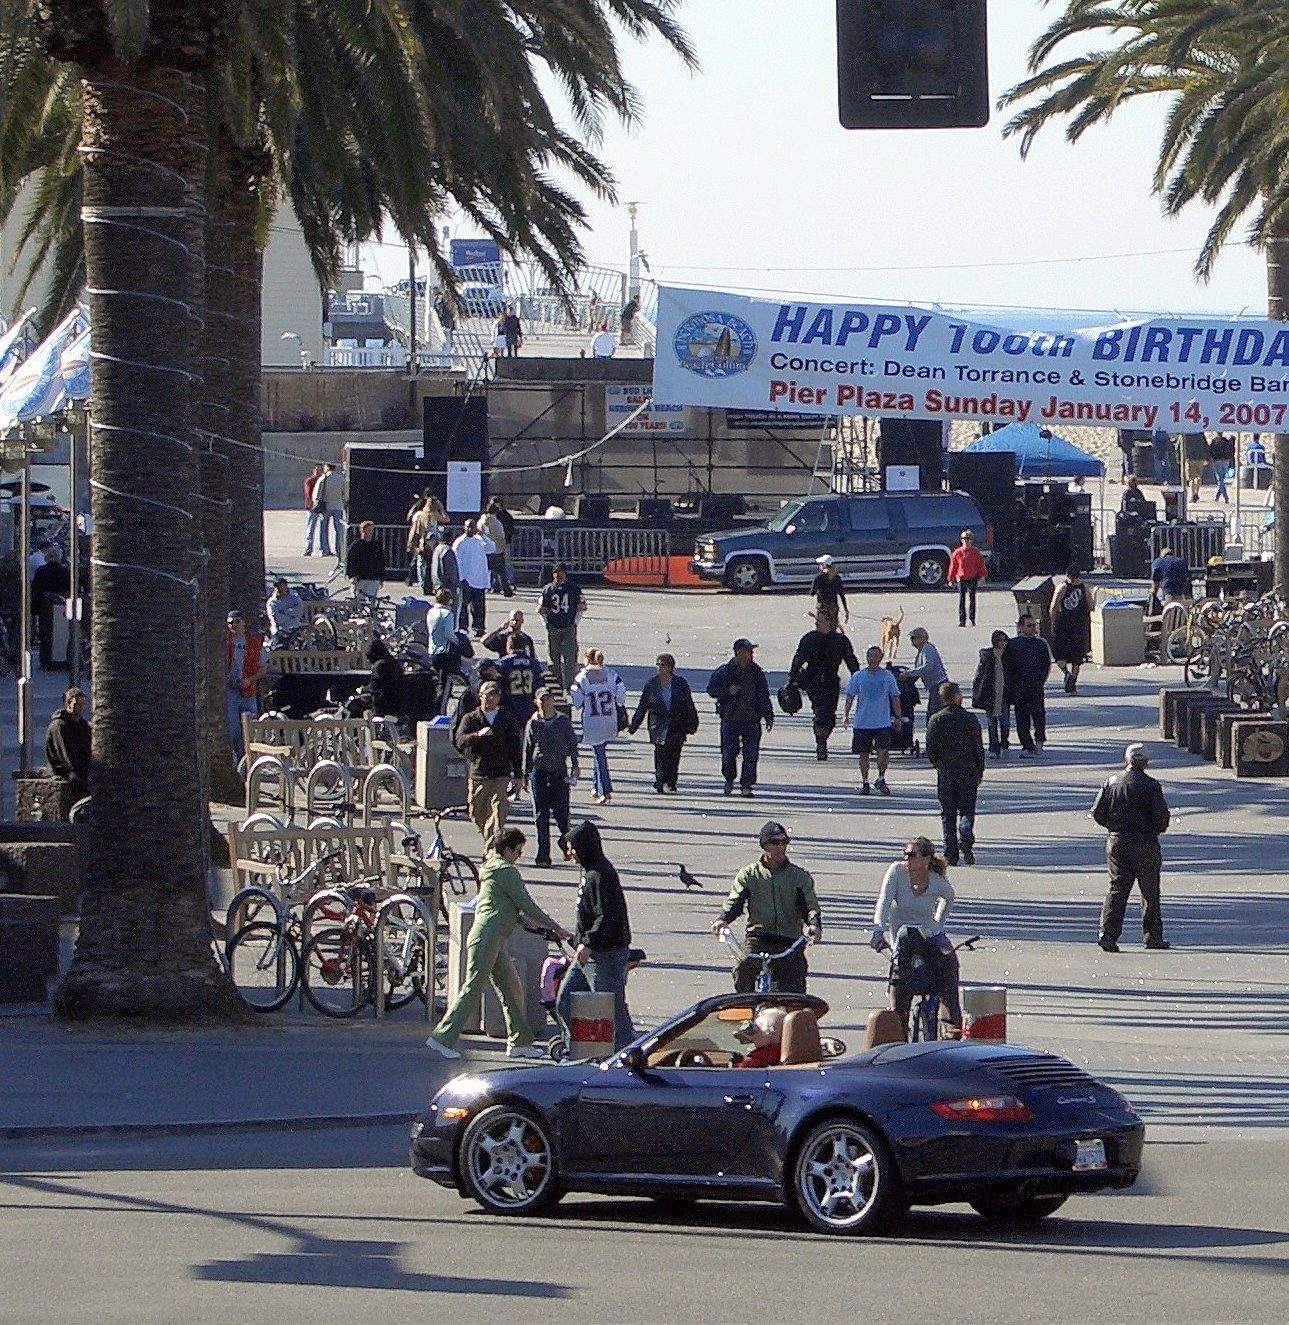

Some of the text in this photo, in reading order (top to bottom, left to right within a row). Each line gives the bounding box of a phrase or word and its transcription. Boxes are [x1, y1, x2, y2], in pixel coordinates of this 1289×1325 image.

[771, 305, 932, 351] HAPPY
[949, 323, 1075, 357] 100th
[770, 353, 874, 375] Concert:
[884, 360, 945, 380] Dean
[955, 366, 1061, 384] Torrance
[1069, 370, 1085, 385] &
[1095, 371, 1241, 394] Stonebridge
[769, 380, 827, 406] Pier
[836, 384, 915, 410] Plaza
[925, 389, 1032, 422] Sunday
[1041, 395, 1158, 428] January
[1170, 401, 1210, 429] 14,
[1219, 402, 1287, 425] 2007
[551, 593, 569, 614] 34
[589, 691, 613, 717] 12
